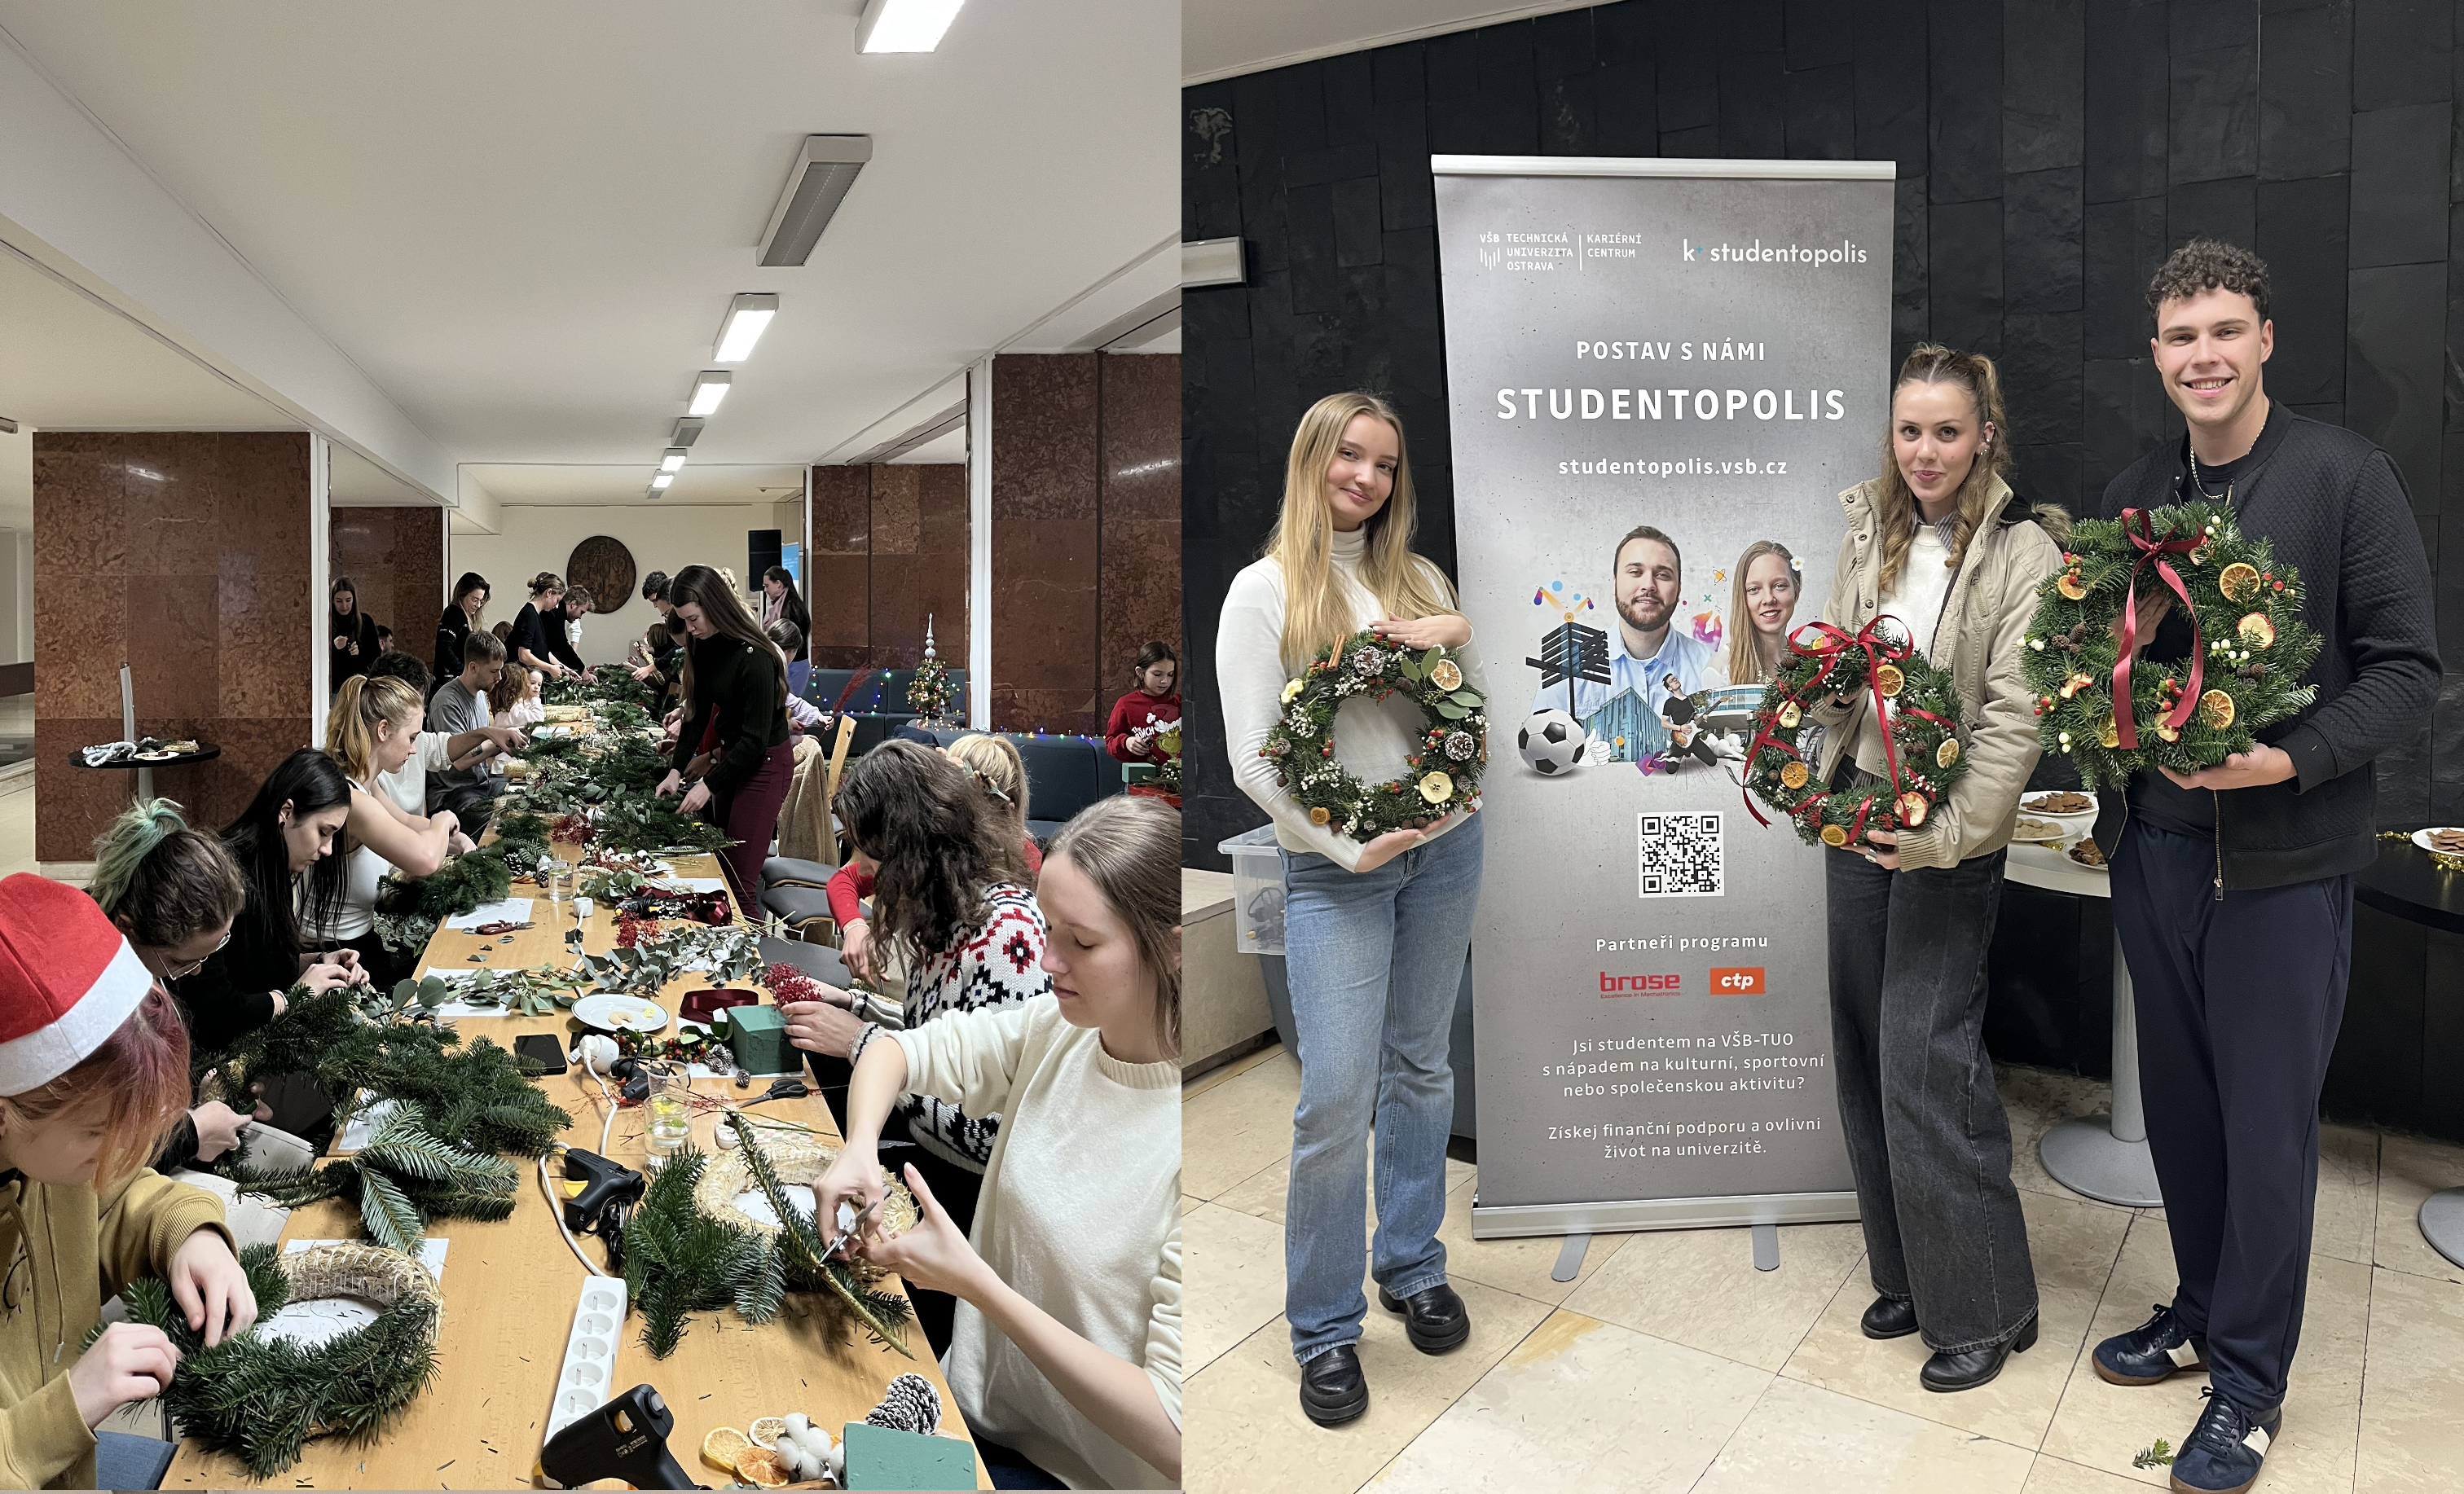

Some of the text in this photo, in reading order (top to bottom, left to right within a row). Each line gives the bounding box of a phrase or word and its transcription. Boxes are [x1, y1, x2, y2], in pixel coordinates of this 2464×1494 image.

[1480, 231, 1568, 243] VŠB TECHNICKÁ
[1587, 233, 1641, 244] KARIÉRNÍ
[1507, 248, 1573, 257] UNIVERZITA
[1588, 248, 1635, 257] CENTRUM
[1711, 239, 1866, 267] studentopolis
[1507, 261, 1553, 270] OSTRAVA
[1577, 337, 1763, 360] POSTAV S NÁMI
[1498, 389, 1844, 420] STUDENTOPOLIS
[1560, 458, 1786, 478] studentopolis.vsb.cz
[1597, 935, 1767, 951] Partneři programu
[1600, 972, 1679, 991] brose
[1722, 973, 1753, 990] ctp
[1573, 1030, 1793, 1055] Jsi studentem na VŠB-TUO
[1543, 1054, 1824, 1079] s nápadem na kulturní, sportovní
[1564, 1077, 1804, 1096] nebo společenskou aktivitu?
[1549, 1118, 1819, 1140] Získej finanční podporu a ovlivni
[1605, 1140, 1766, 1158] život na univerzitě.
